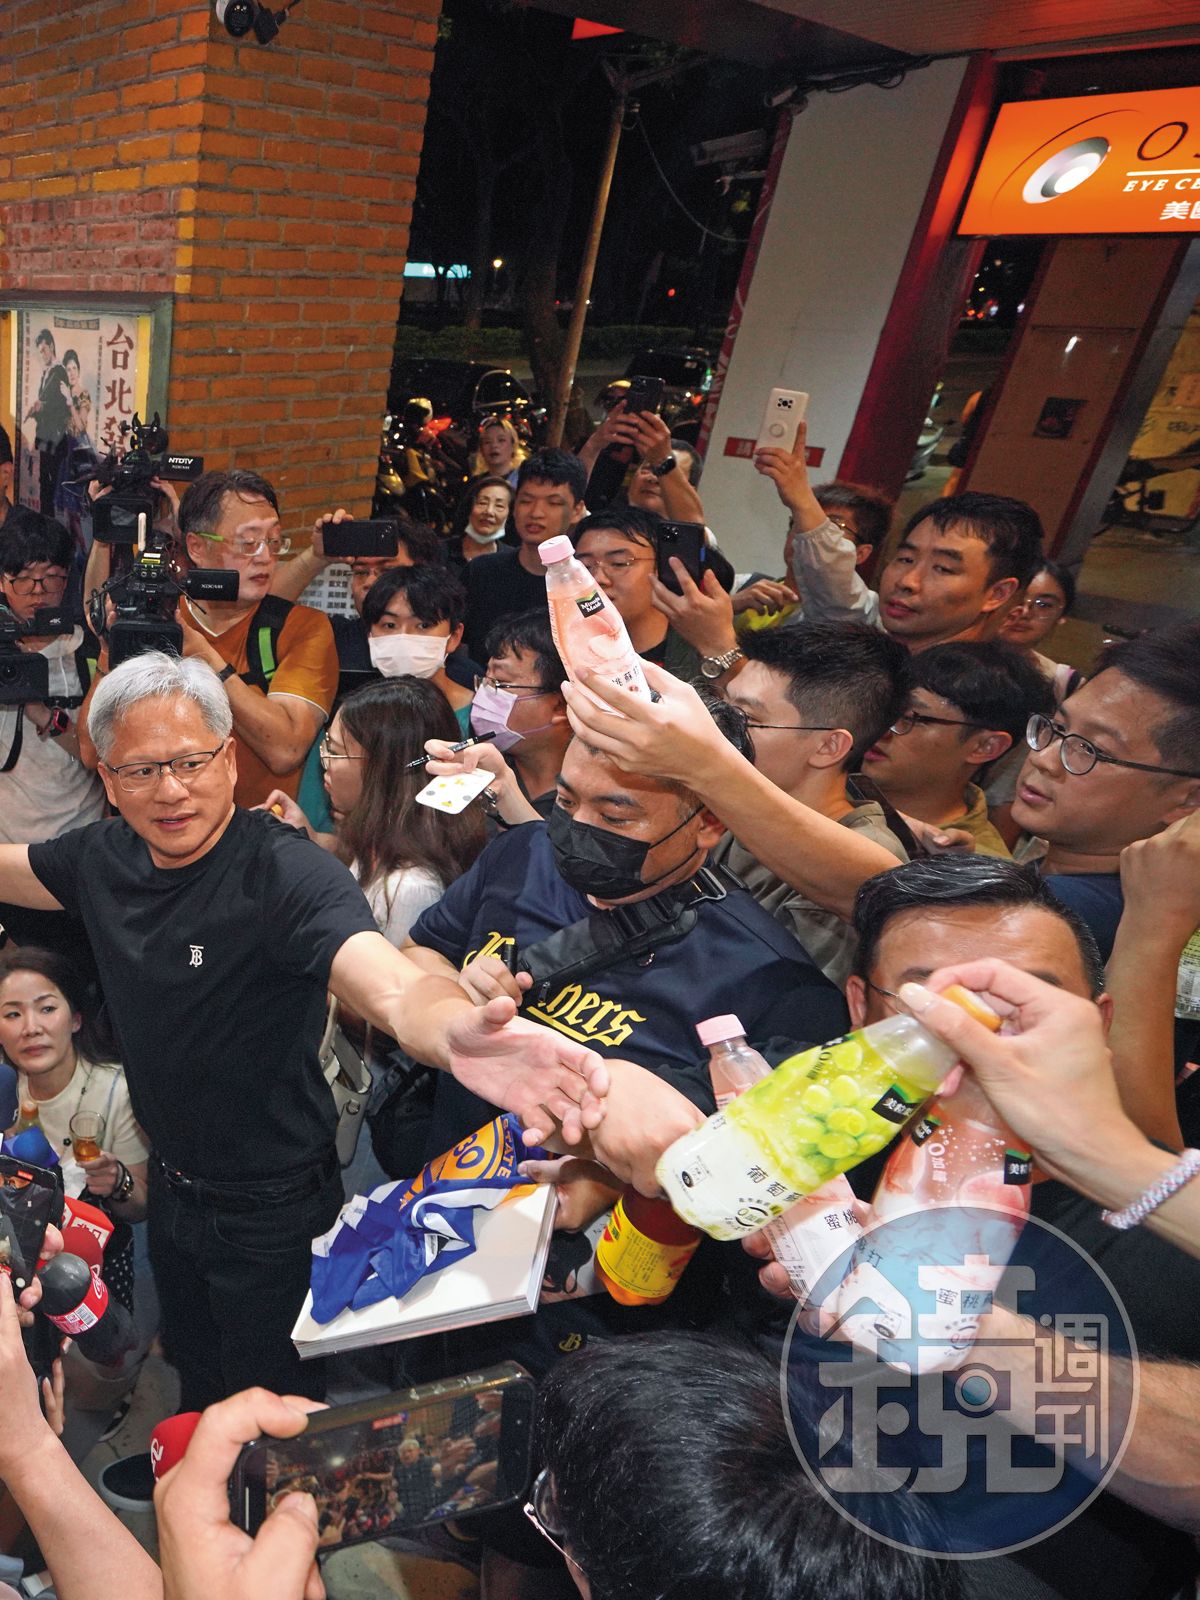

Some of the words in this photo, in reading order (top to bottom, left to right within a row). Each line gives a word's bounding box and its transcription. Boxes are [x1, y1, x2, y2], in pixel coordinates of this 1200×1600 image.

[1122, 179, 1169, 192] EYE
[168, 457, 194, 465] NTDTV
[453, 1133, 486, 1170] 30
[497, 1118, 516, 1179] STATE
